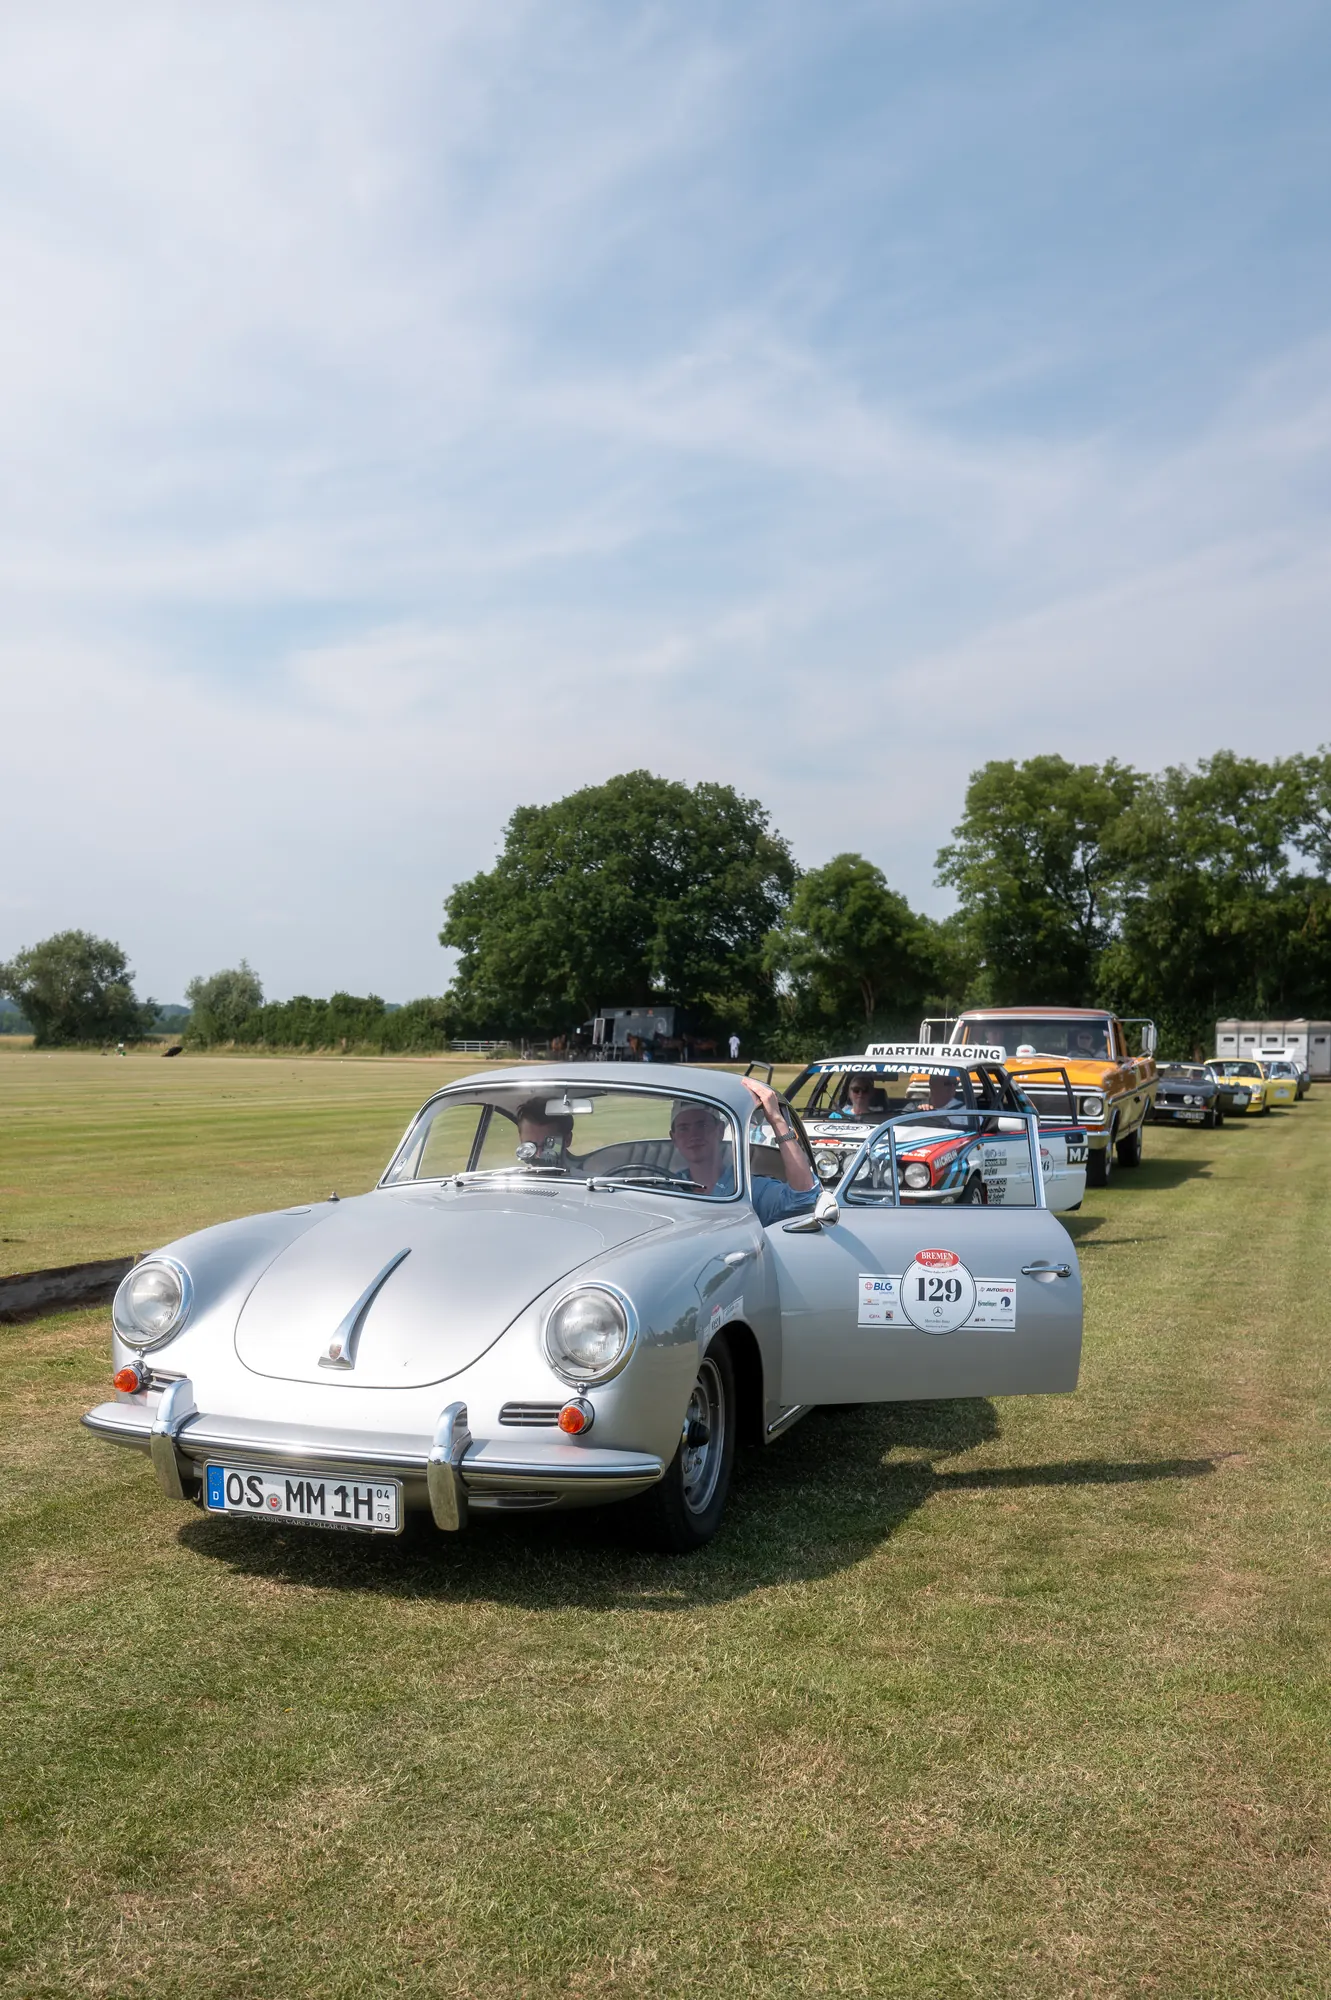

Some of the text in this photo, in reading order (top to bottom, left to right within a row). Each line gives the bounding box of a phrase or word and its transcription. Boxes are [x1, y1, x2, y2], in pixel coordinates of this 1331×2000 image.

[872, 1046, 1001, 1060] MARTINI RACING
[819, 1064, 950, 1076] LANCIA MARTINI
[933, 1149, 958, 1170] MICHELIN
[921, 1251, 954, 1260] BREMEN
[873, 1282, 893, 1291] BLG
[915, 1277, 962, 1303] 129
[213, 1490, 219, 1501] D
[226, 1472, 373, 1521] OS MM 1H
[376, 1489, 390, 1500] 04
[376, 1511, 391, 1522] 09
